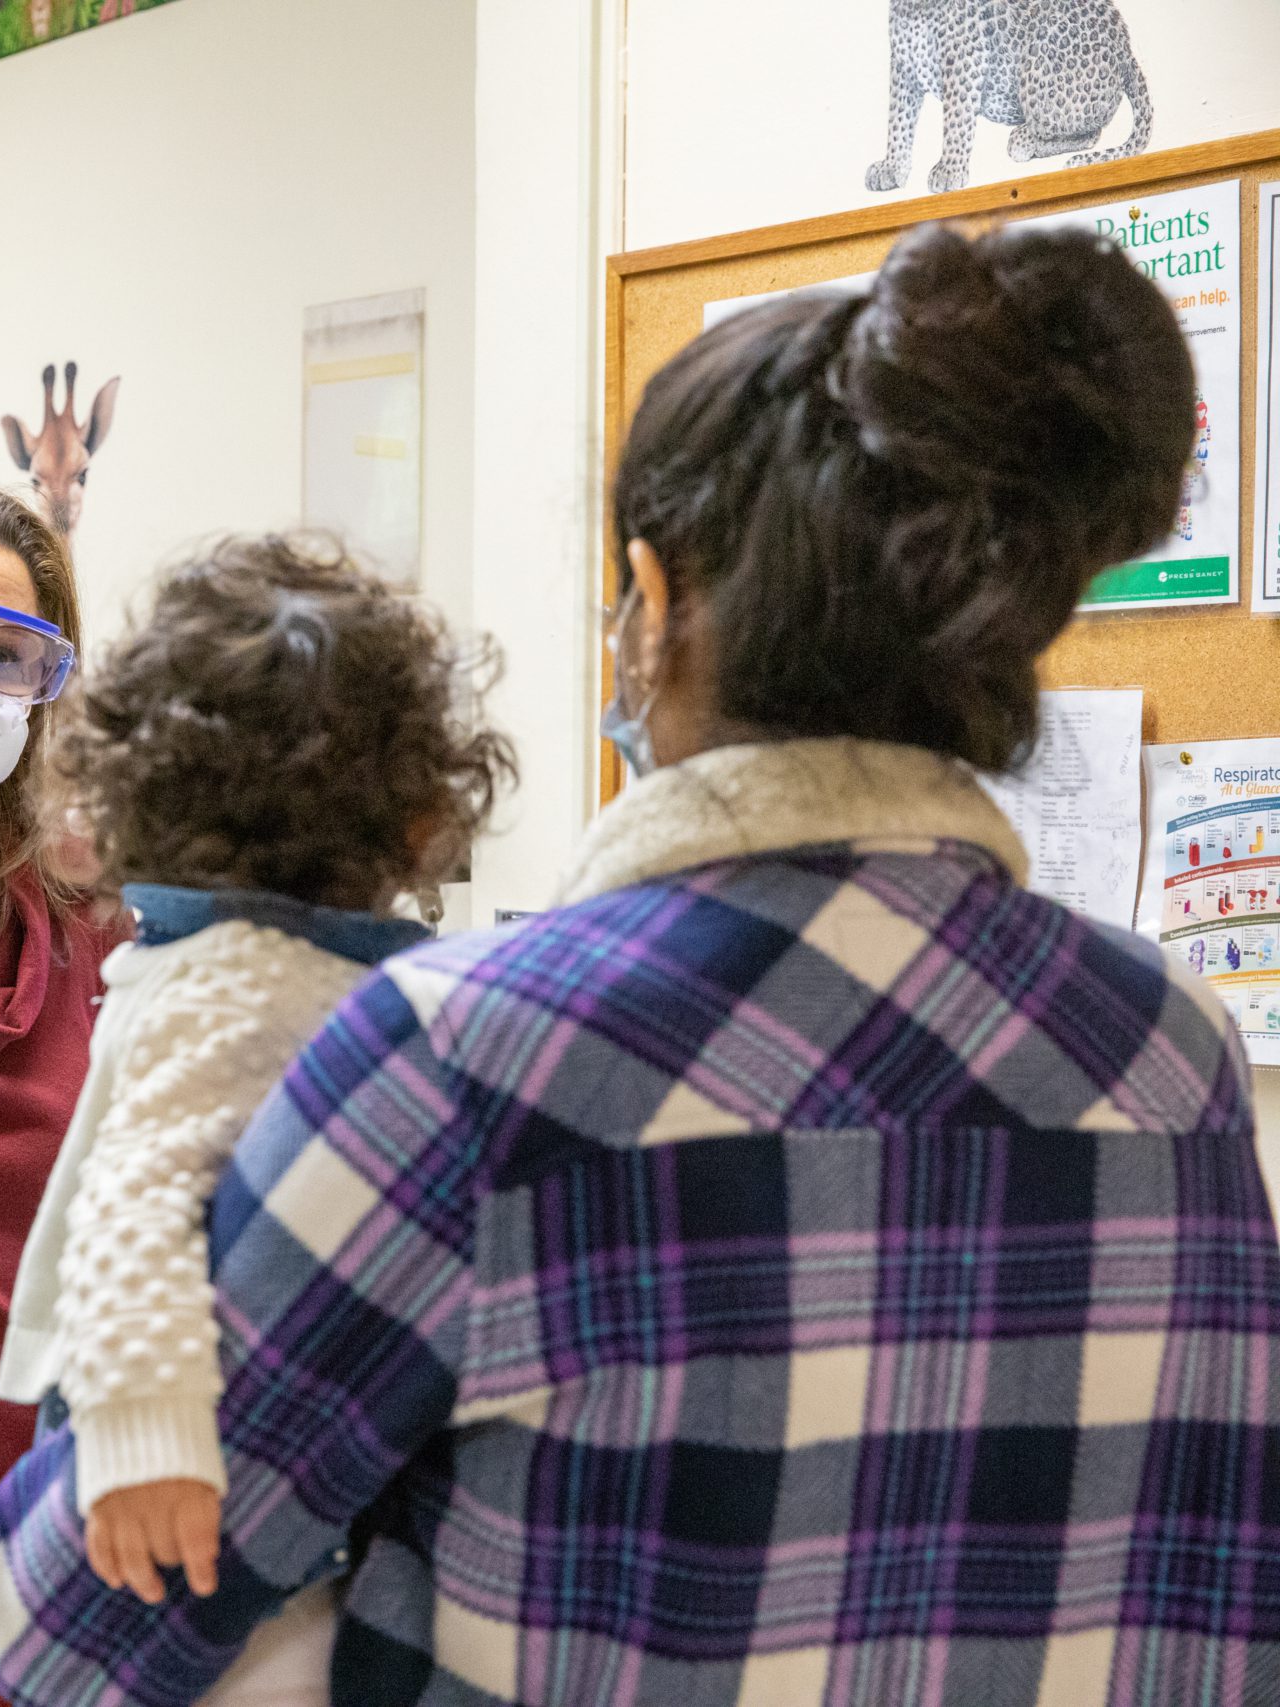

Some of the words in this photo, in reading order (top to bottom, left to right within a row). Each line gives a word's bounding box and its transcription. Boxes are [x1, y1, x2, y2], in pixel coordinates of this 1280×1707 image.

[1096, 208, 1210, 250] Patients
[1134, 241, 1226, 281] ortant
[1200, 288, 1230, 307] help.
[1214, 766, 1280, 785] Respirato
[1220, 783, 1233, 796] At
[1235, 786, 1242, 795] a
